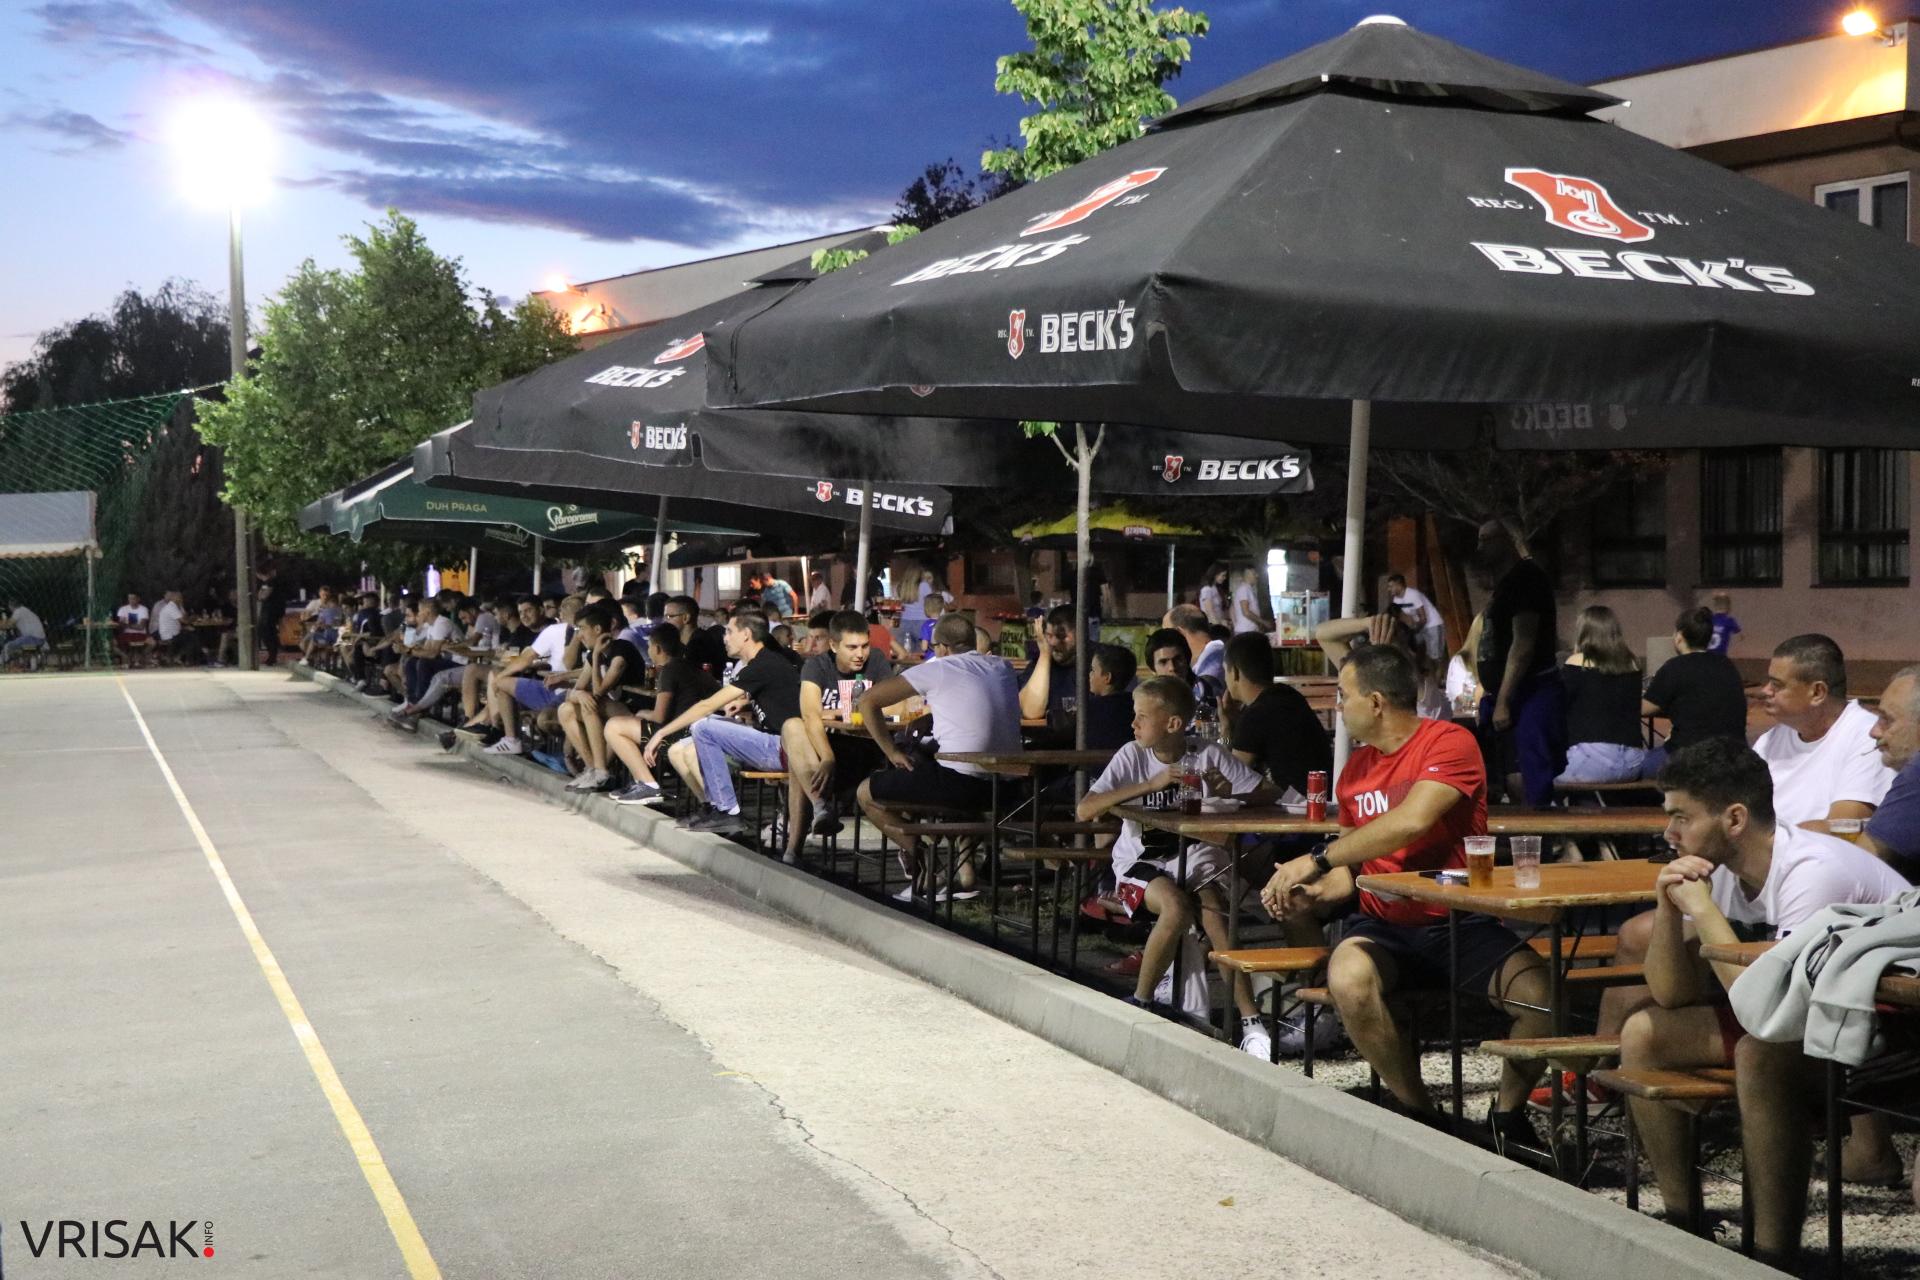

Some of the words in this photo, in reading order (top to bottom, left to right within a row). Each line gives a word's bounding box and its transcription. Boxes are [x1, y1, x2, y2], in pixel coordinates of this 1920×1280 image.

[1467, 196, 1534, 210] REG.
[1637, 210, 1690, 226] TM.
[890, 233, 1091, 286] BECK'S
[1470, 241, 1816, 296] BECK'S
[1040, 299, 1136, 353] BECK'S
[584, 365, 687, 388] BECK'S
[645, 423, 688, 450] BECK'S
[1198, 455, 1300, 481] BECK'S
[426, 501, 449, 511] DUH
[451, 502, 488, 513] PRAGA
[845, 487, 934, 517] BECK'S
